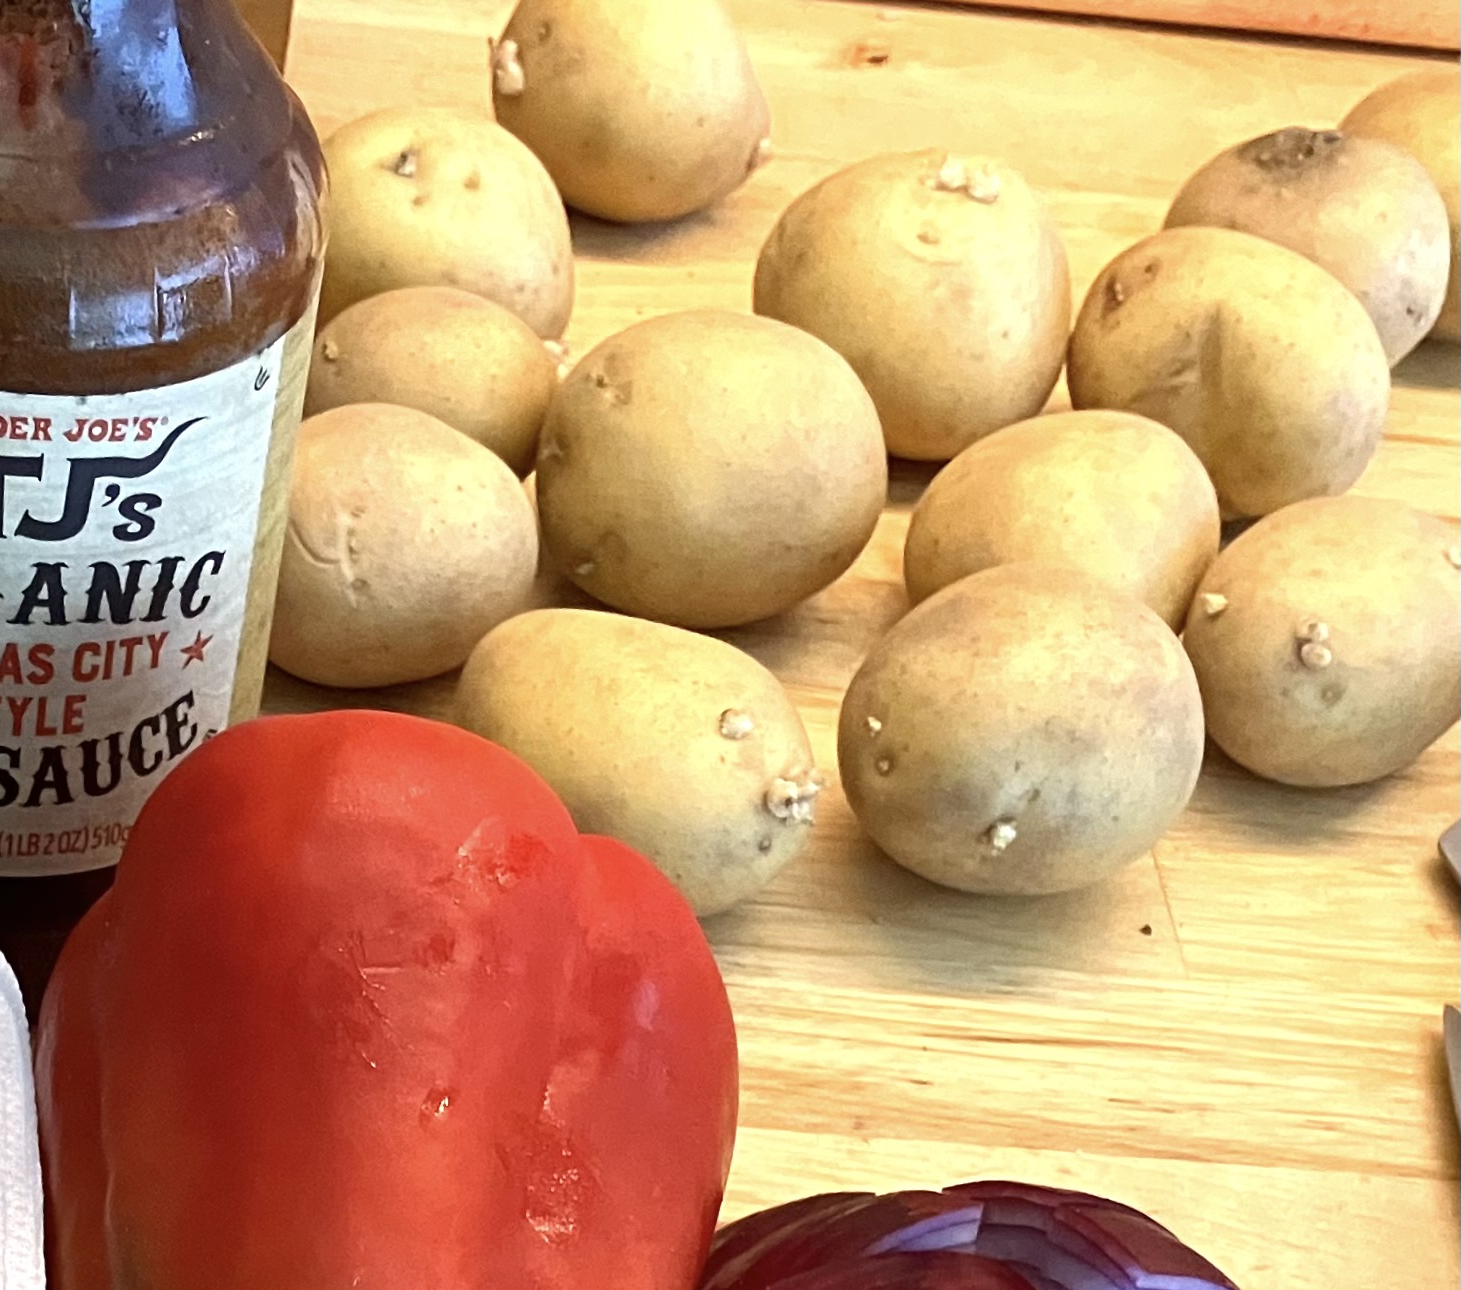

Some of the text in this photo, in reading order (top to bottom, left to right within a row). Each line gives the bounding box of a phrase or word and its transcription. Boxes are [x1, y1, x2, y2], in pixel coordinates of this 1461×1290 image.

[62, 416, 159, 442] JOE'S
[72, 630, 171, 683] CITY
[16, 832, 38, 857] LB
[42, 832, 54, 856] 2
[57, 827, 89, 855] OZ)
